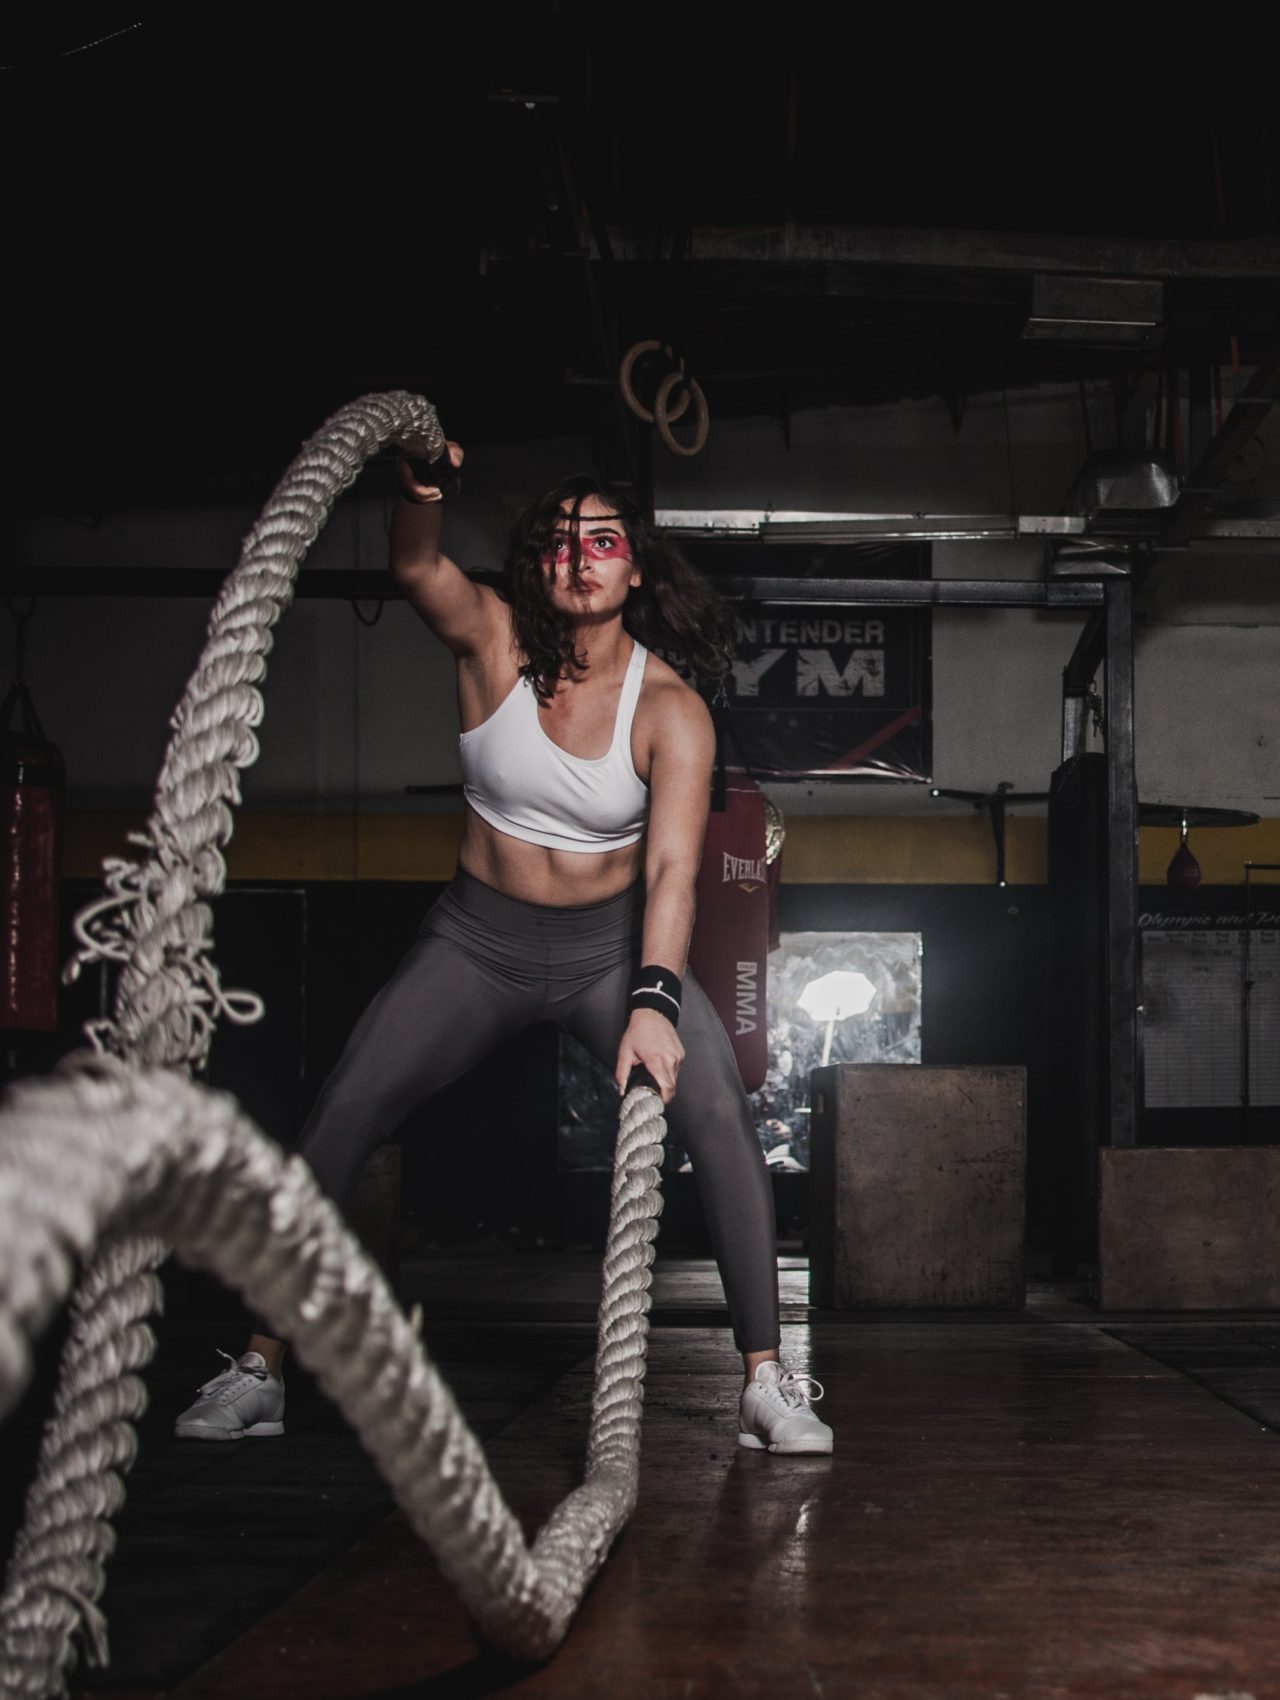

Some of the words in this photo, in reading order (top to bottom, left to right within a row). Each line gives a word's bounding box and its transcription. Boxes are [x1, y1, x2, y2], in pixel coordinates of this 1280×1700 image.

[736, 619, 885, 644] NTENDER
[732, 648, 885, 697] YM
[722, 851, 767, 884] EVERLAS
[1138, 912, 1211, 930] Olympic
[1215, 912, 1254, 927] and
[736, 961, 758, 1036] MMA
